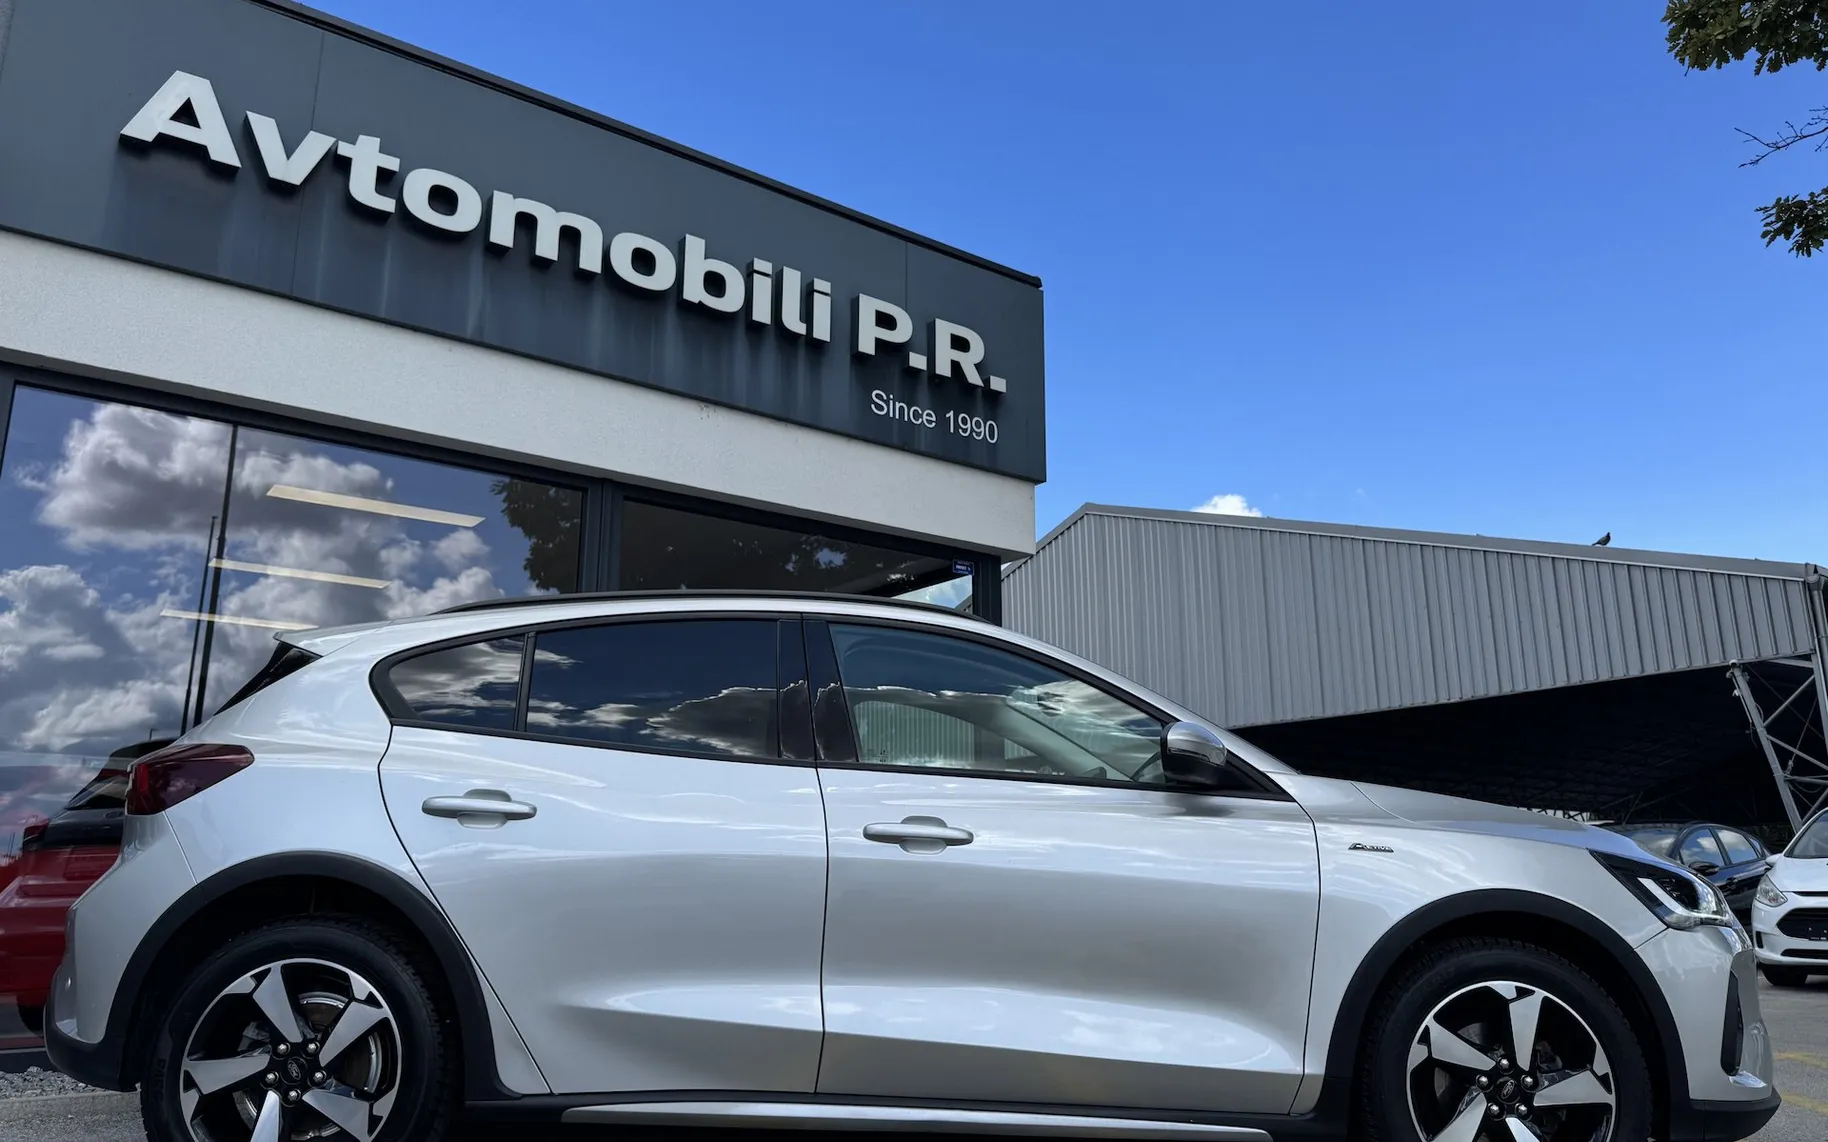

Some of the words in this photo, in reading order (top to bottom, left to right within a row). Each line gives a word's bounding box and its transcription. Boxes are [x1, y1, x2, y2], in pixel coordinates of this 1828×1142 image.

[119, 70, 831, 342] Avtomobili
[857, 293, 1007, 393] P.R.
[871, 390, 937, 428] Since
[945, 410, 999, 444] 1990
